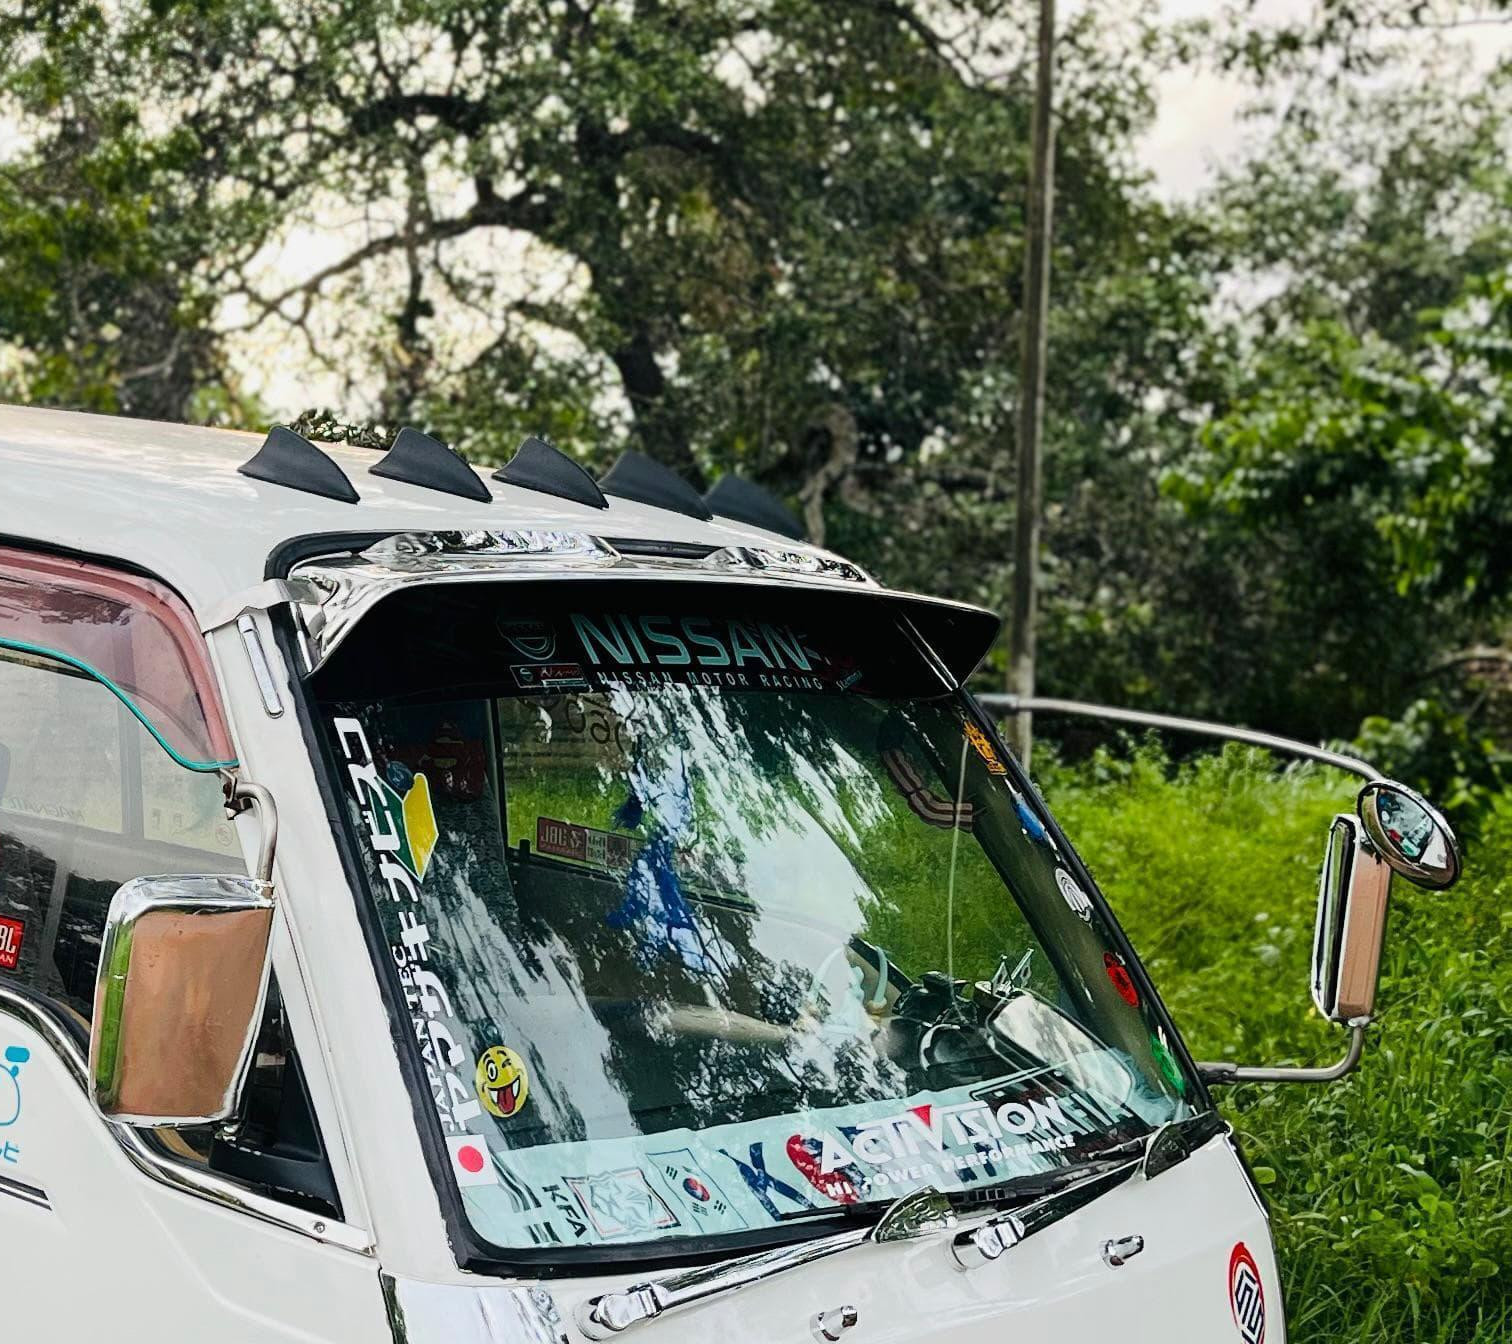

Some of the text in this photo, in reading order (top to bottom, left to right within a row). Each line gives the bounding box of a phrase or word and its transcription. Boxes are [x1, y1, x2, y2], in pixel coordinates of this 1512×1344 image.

[570, 613, 813, 671] NISSAN
[598, 671, 675, 688] NISSAN
[687, 671, 748, 687] MOTOR
[760, 673, 823, 690] RACING
[819, 1096, 1070, 1175] ACTIVISION
[944, 1134, 1077, 1175] PERFORMANCE
